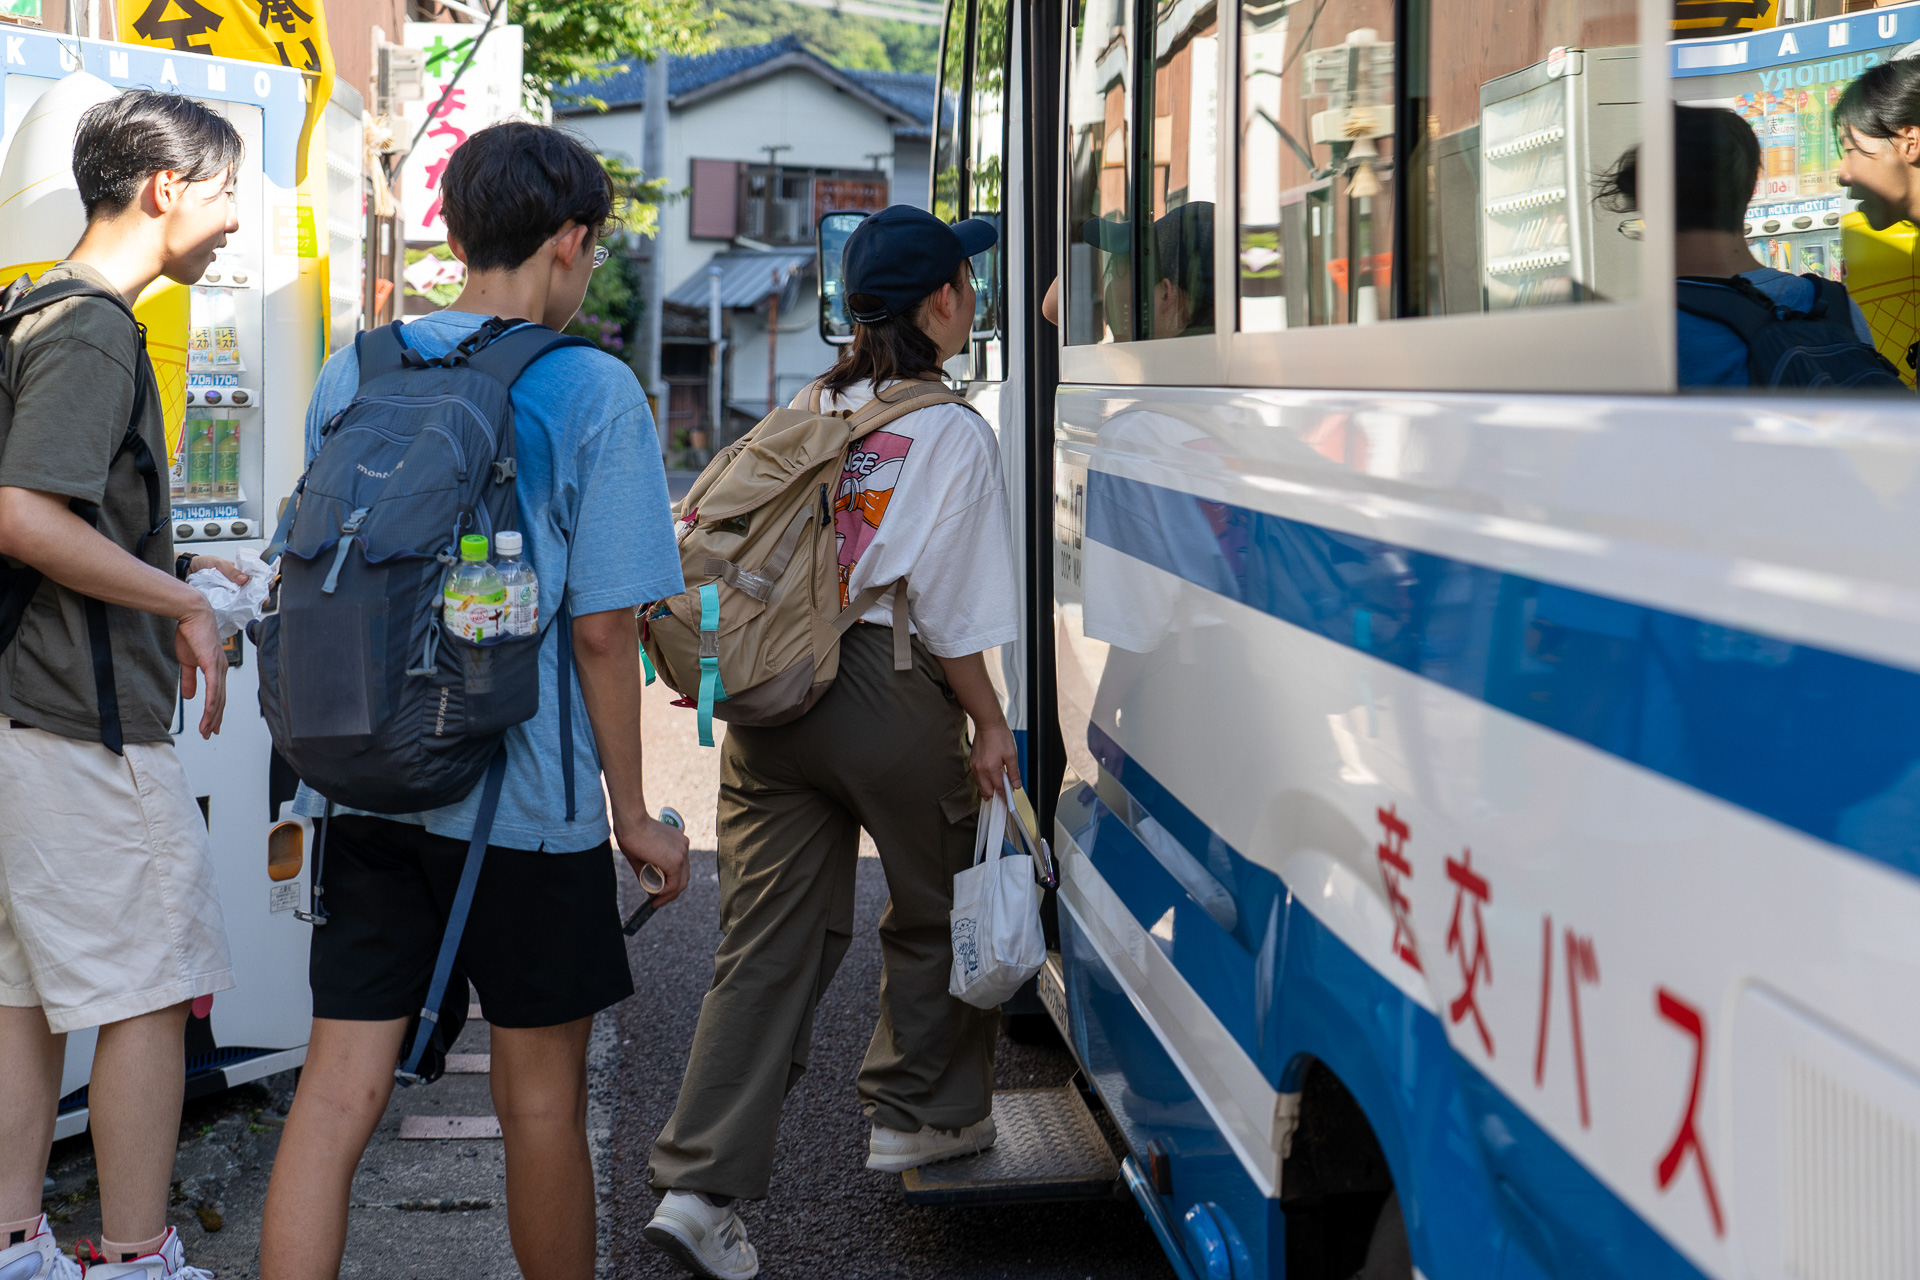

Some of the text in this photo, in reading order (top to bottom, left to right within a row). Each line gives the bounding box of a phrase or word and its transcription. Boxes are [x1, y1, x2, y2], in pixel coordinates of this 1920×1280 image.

[6, 36, 312, 103] KUMAMON
[214, 374, 238, 386] 170円
[186, 507, 211, 518] 140円
[214, 505, 238, 517] 140円
[438, 696, 448, 716] PACK
[435, 715, 445, 736] FIRST
